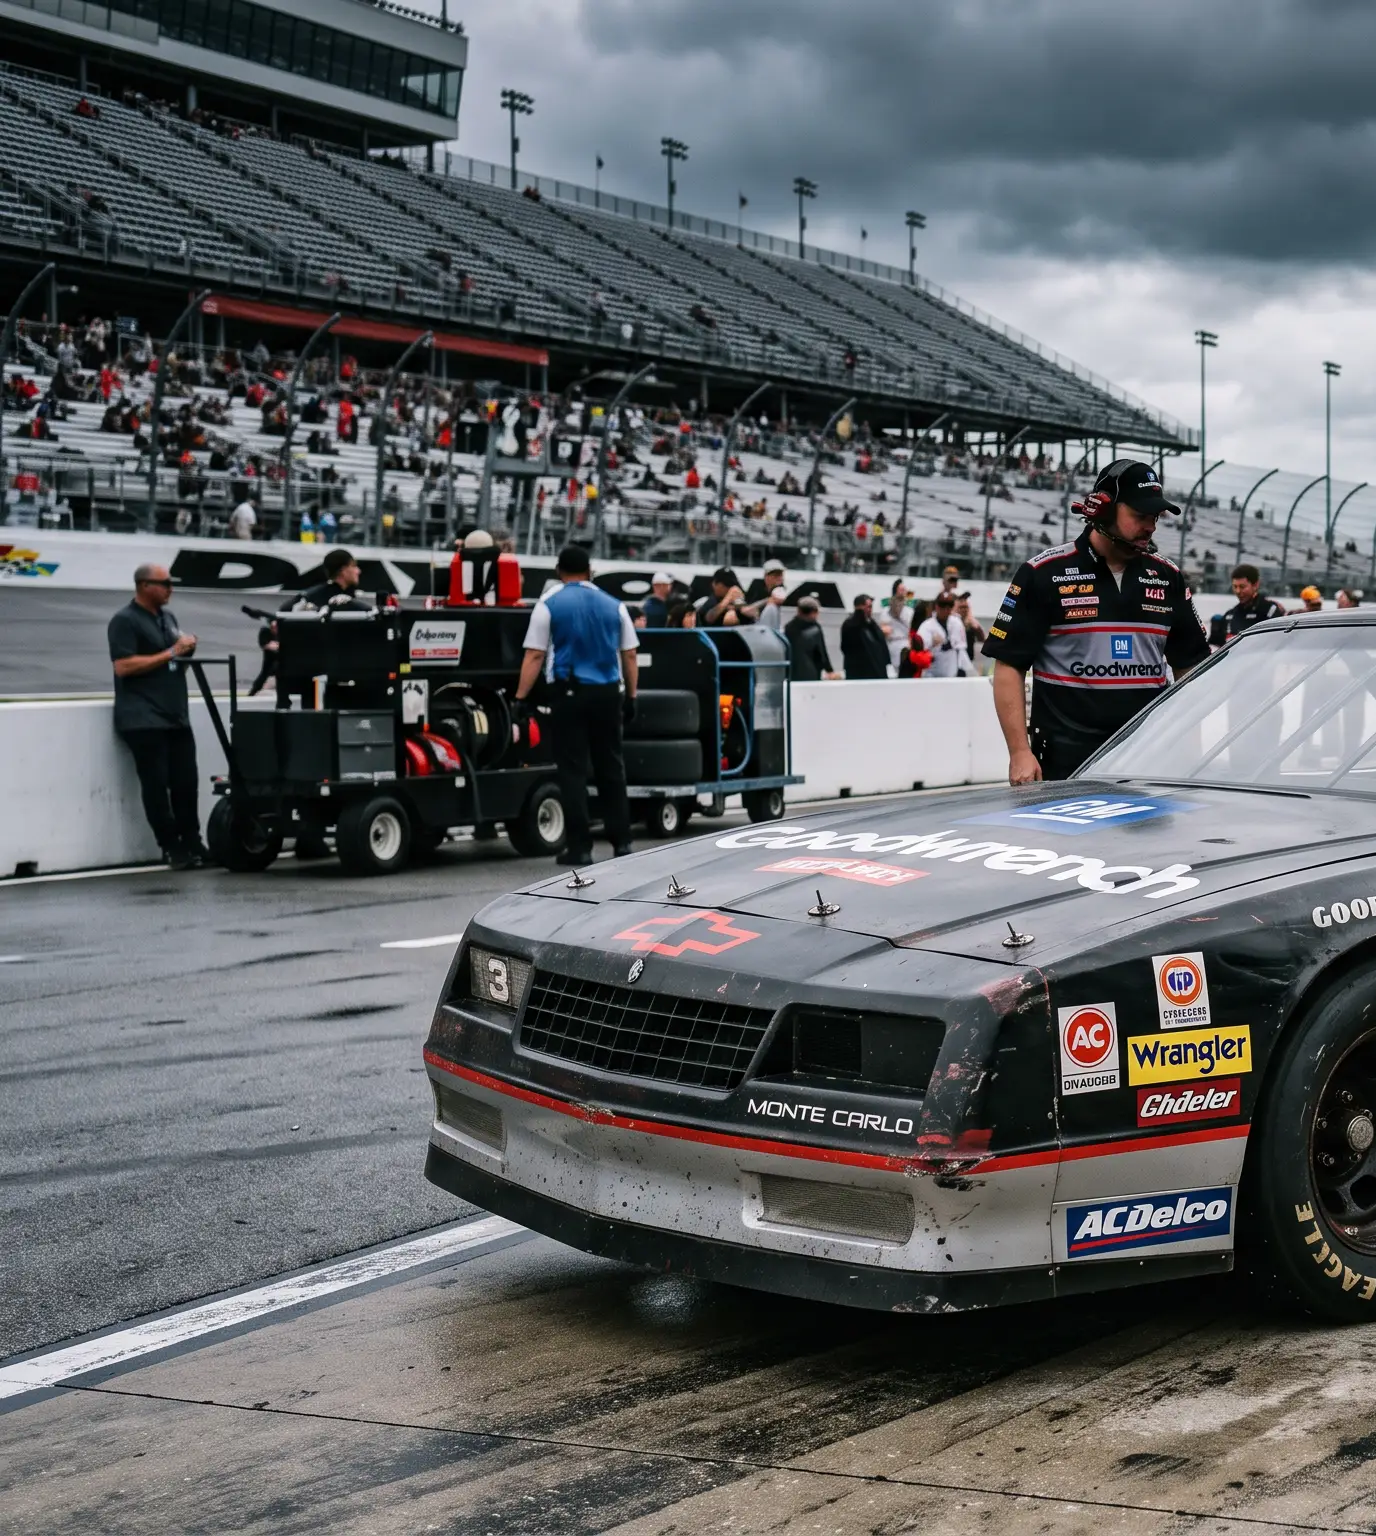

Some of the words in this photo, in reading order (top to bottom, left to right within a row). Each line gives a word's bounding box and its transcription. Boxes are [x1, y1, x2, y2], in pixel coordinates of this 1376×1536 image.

[1038, 800, 1157, 819] GM
[715, 827, 1201, 899] Goodwrench
[488, 957, 510, 1002] 3
[1071, 1023, 1106, 1051] AC
[1131, 1034, 1247, 1075] Wrangler
[747, 1098, 827, 1124] MONTE
[831, 1109, 914, 1135] CARLO
[1073, 1196, 1228, 1240] ACDelco
